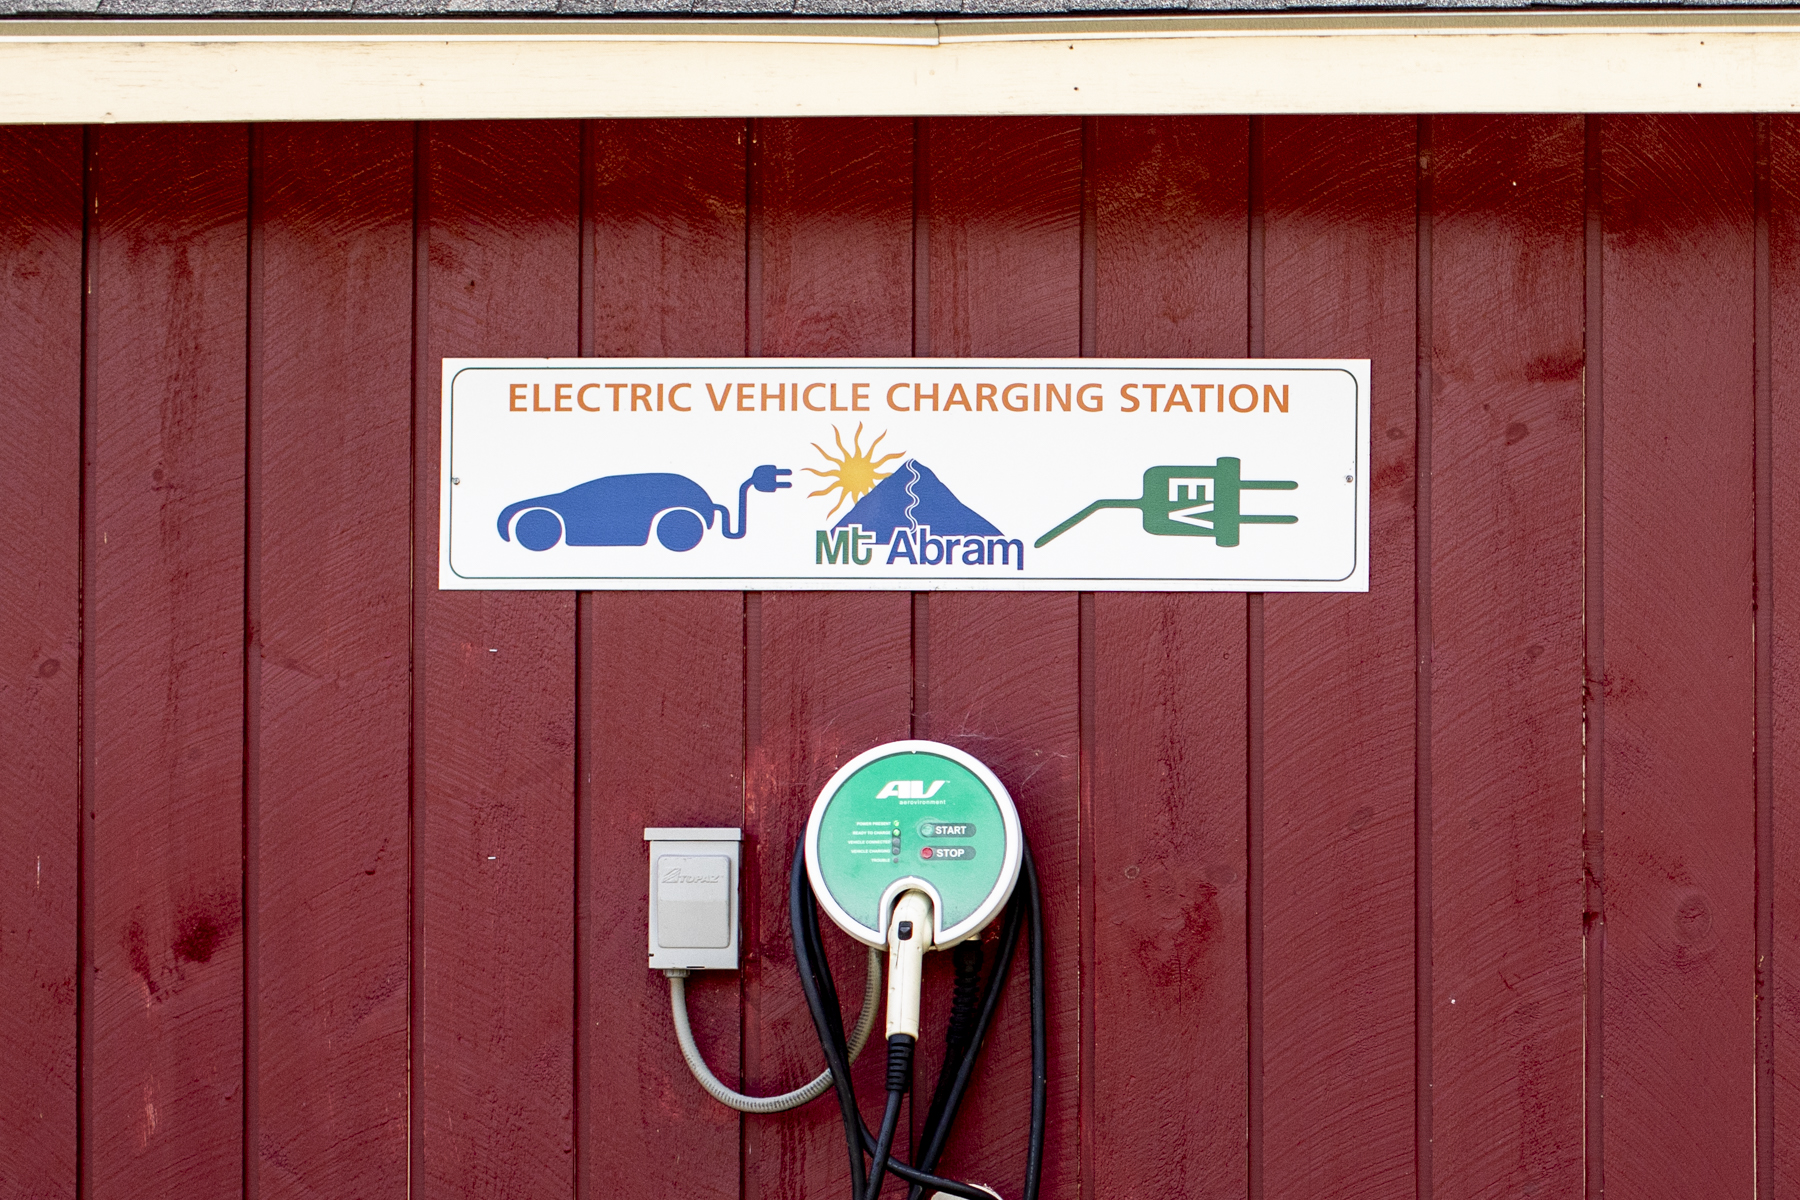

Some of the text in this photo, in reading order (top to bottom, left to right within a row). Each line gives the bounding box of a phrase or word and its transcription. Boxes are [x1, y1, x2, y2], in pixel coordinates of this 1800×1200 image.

[509, 382, 1290, 414] ELECTRIC VEHICLE CHARGING STATION
[1168, 477, 1214, 530] EV
[815, 526, 1024, 570] Mt Abram
[935, 826, 967, 835] START
[936, 848, 965, 858] STOP
[678, 875, 720, 883] TOPAZ
